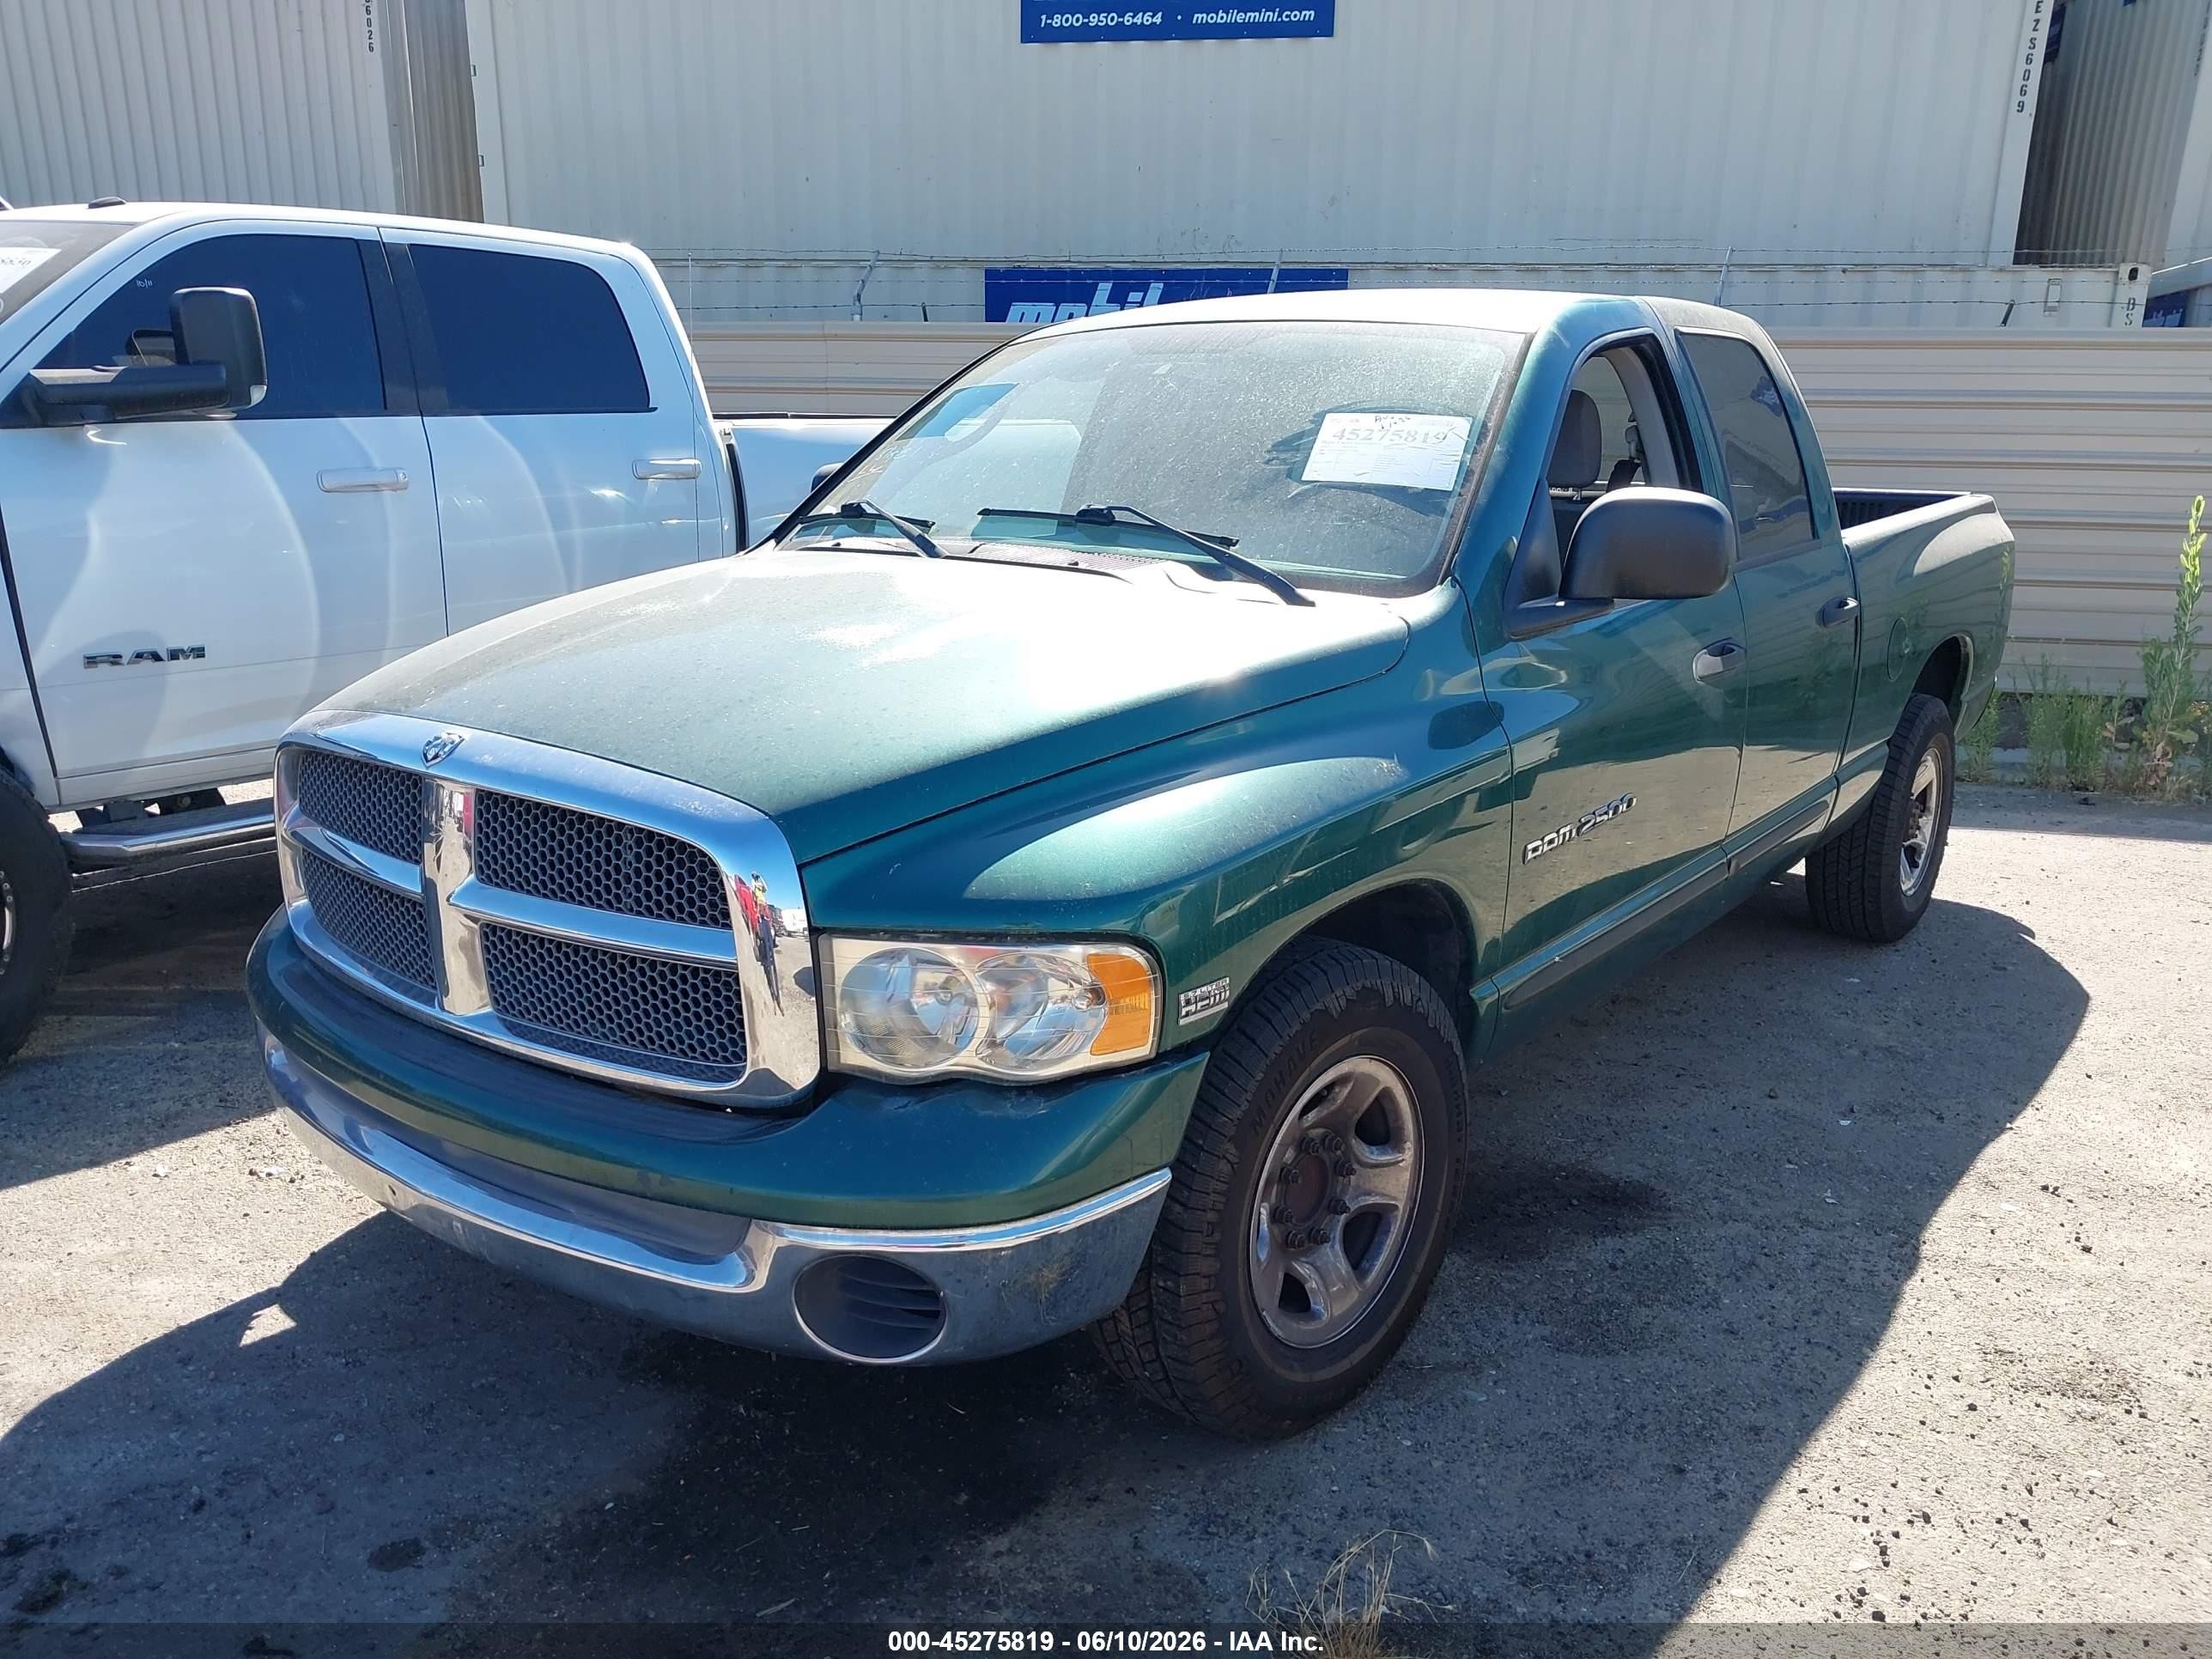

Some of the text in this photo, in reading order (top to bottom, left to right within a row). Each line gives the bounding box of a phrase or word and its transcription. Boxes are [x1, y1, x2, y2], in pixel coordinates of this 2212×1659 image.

[365, 0, 374, 52] 6026
[1040, 8, 1316, 27] 1-800-950-6464 mobilemini.com
[83, 644, 206, 669] RAM
[1522, 792, 1637, 865] RAM 2500
